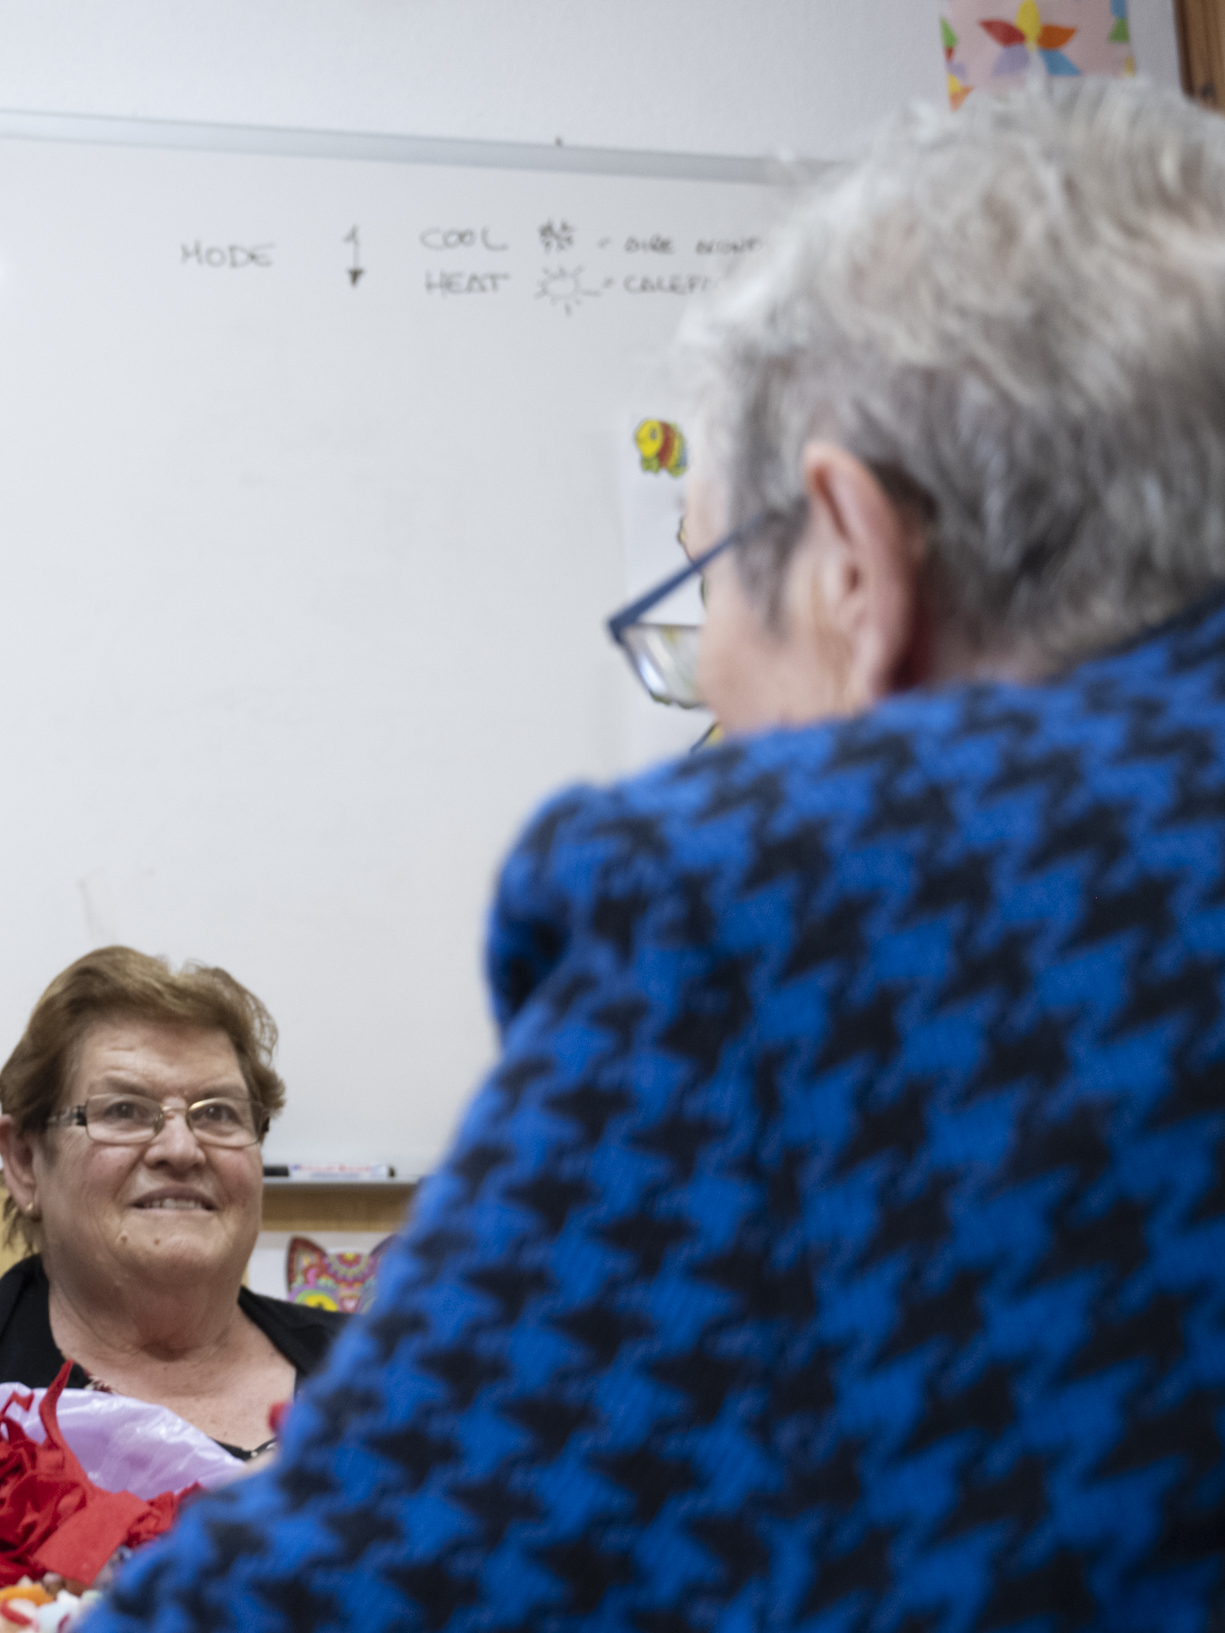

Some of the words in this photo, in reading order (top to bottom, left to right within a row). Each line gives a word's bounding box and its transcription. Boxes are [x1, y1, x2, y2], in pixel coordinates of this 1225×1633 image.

[418, 225, 509, 251] COOL
[179, 239, 276, 268] MODE
[424, 269, 511, 297] HEAT
